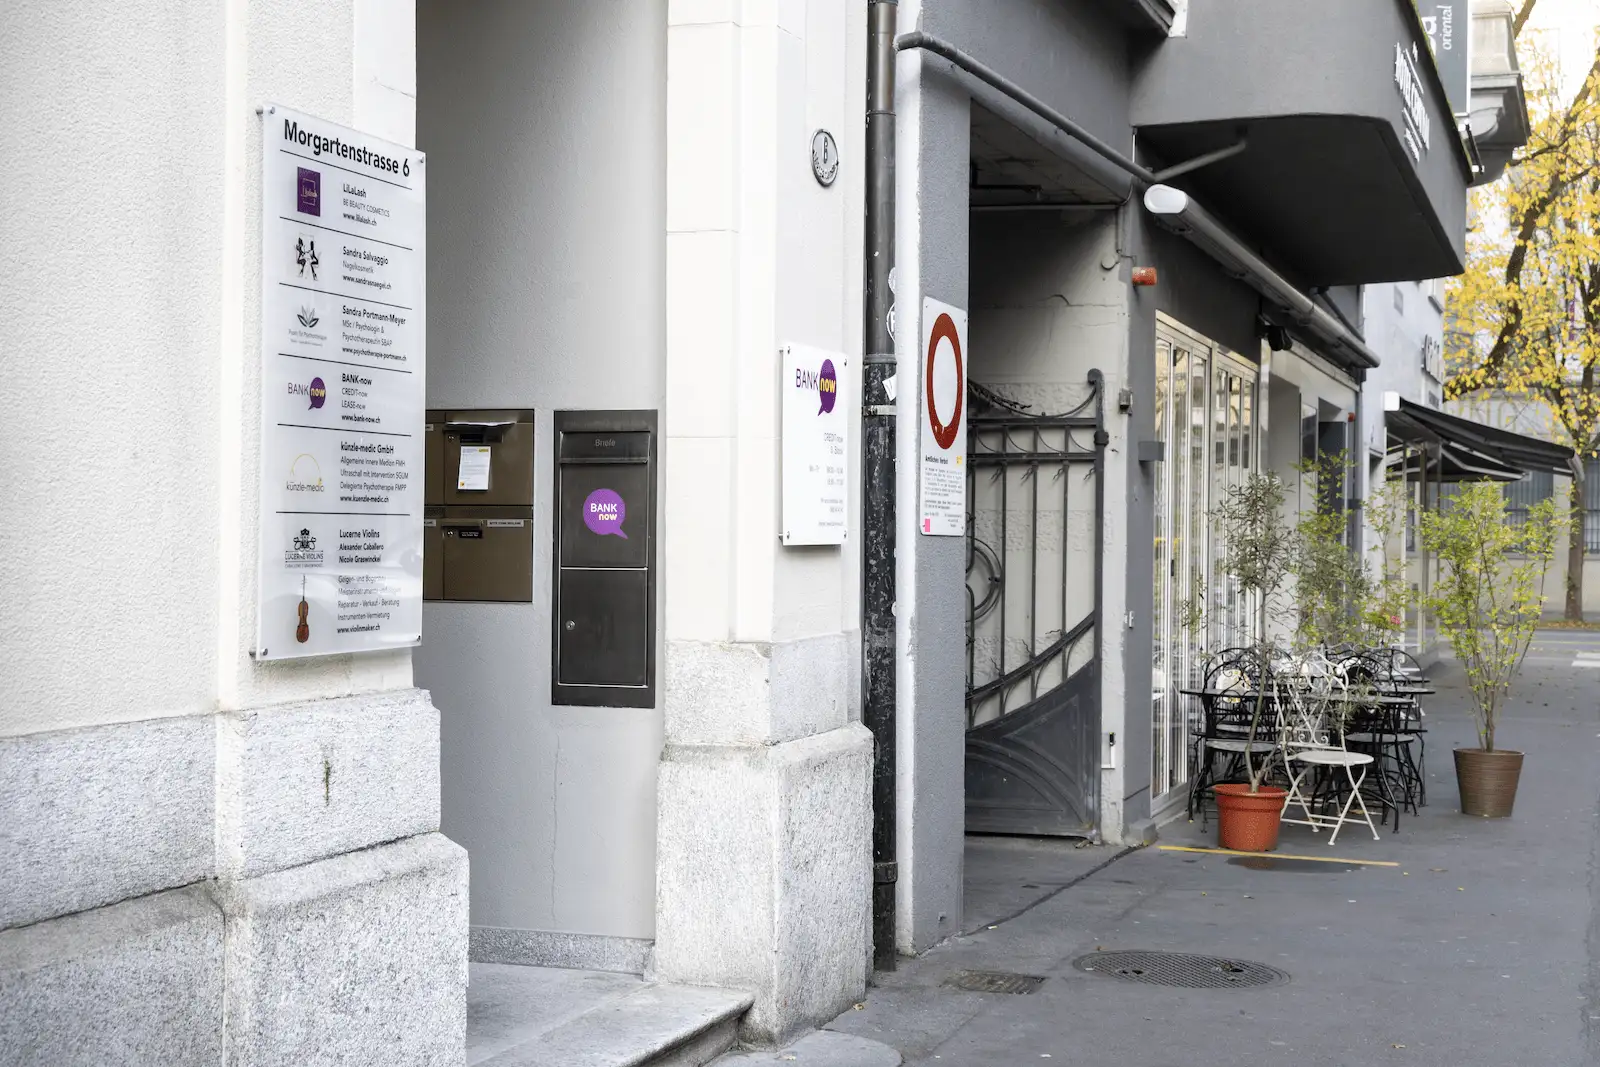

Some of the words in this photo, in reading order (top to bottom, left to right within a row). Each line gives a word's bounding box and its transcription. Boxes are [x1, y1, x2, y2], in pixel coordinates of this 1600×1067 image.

[1436, 5, 1452, 50] oriental
[284, 118, 399, 175] Morgartenstrasse
[402, 158, 411, 178] 6
[343, 183, 367, 199] LiLaLash
[343, 198, 349, 206] BE
[350, 199, 366, 210] BEAUTY
[366, 203, 390, 218] COSMETICS
[343, 246, 362, 259] Sandra
[363, 250, 389, 266] Salvaggio
[343, 305, 361, 318] Sandra
[362, 308, 406, 326] Portmann-Meyer
[342, 320, 353, 329] MSc
[356, 320, 380, 334] Psychologin
[341, 373, 373, 386] BANK-now
[796, 368, 819, 391] BANK
[819, 377, 837, 394] now
[287, 382, 310, 397] BANK
[310, 387, 326, 397] now
[341, 387, 369, 398] CREDIT-now
[341, 400, 366, 410] LEASE-now
[341, 413, 381, 424] www.bank-now.ch
[340, 441, 377, 454] künzle-medic
[377, 444, 395, 455] GmbH
[595, 438, 616, 448] Briefe
[590, 503, 618, 514] BANK
[598, 513, 618, 521] now
[339, 529, 361, 538] Lucerne
[362, 529, 380, 538] Violins
[338, 542, 362, 551] Alexander
[363, 542, 385, 551] Caballero
[338, 555, 354, 564] Nicole
[381, 598, 400, 608] Beratung
[336, 623, 381, 635] www.violinmaker.ch
